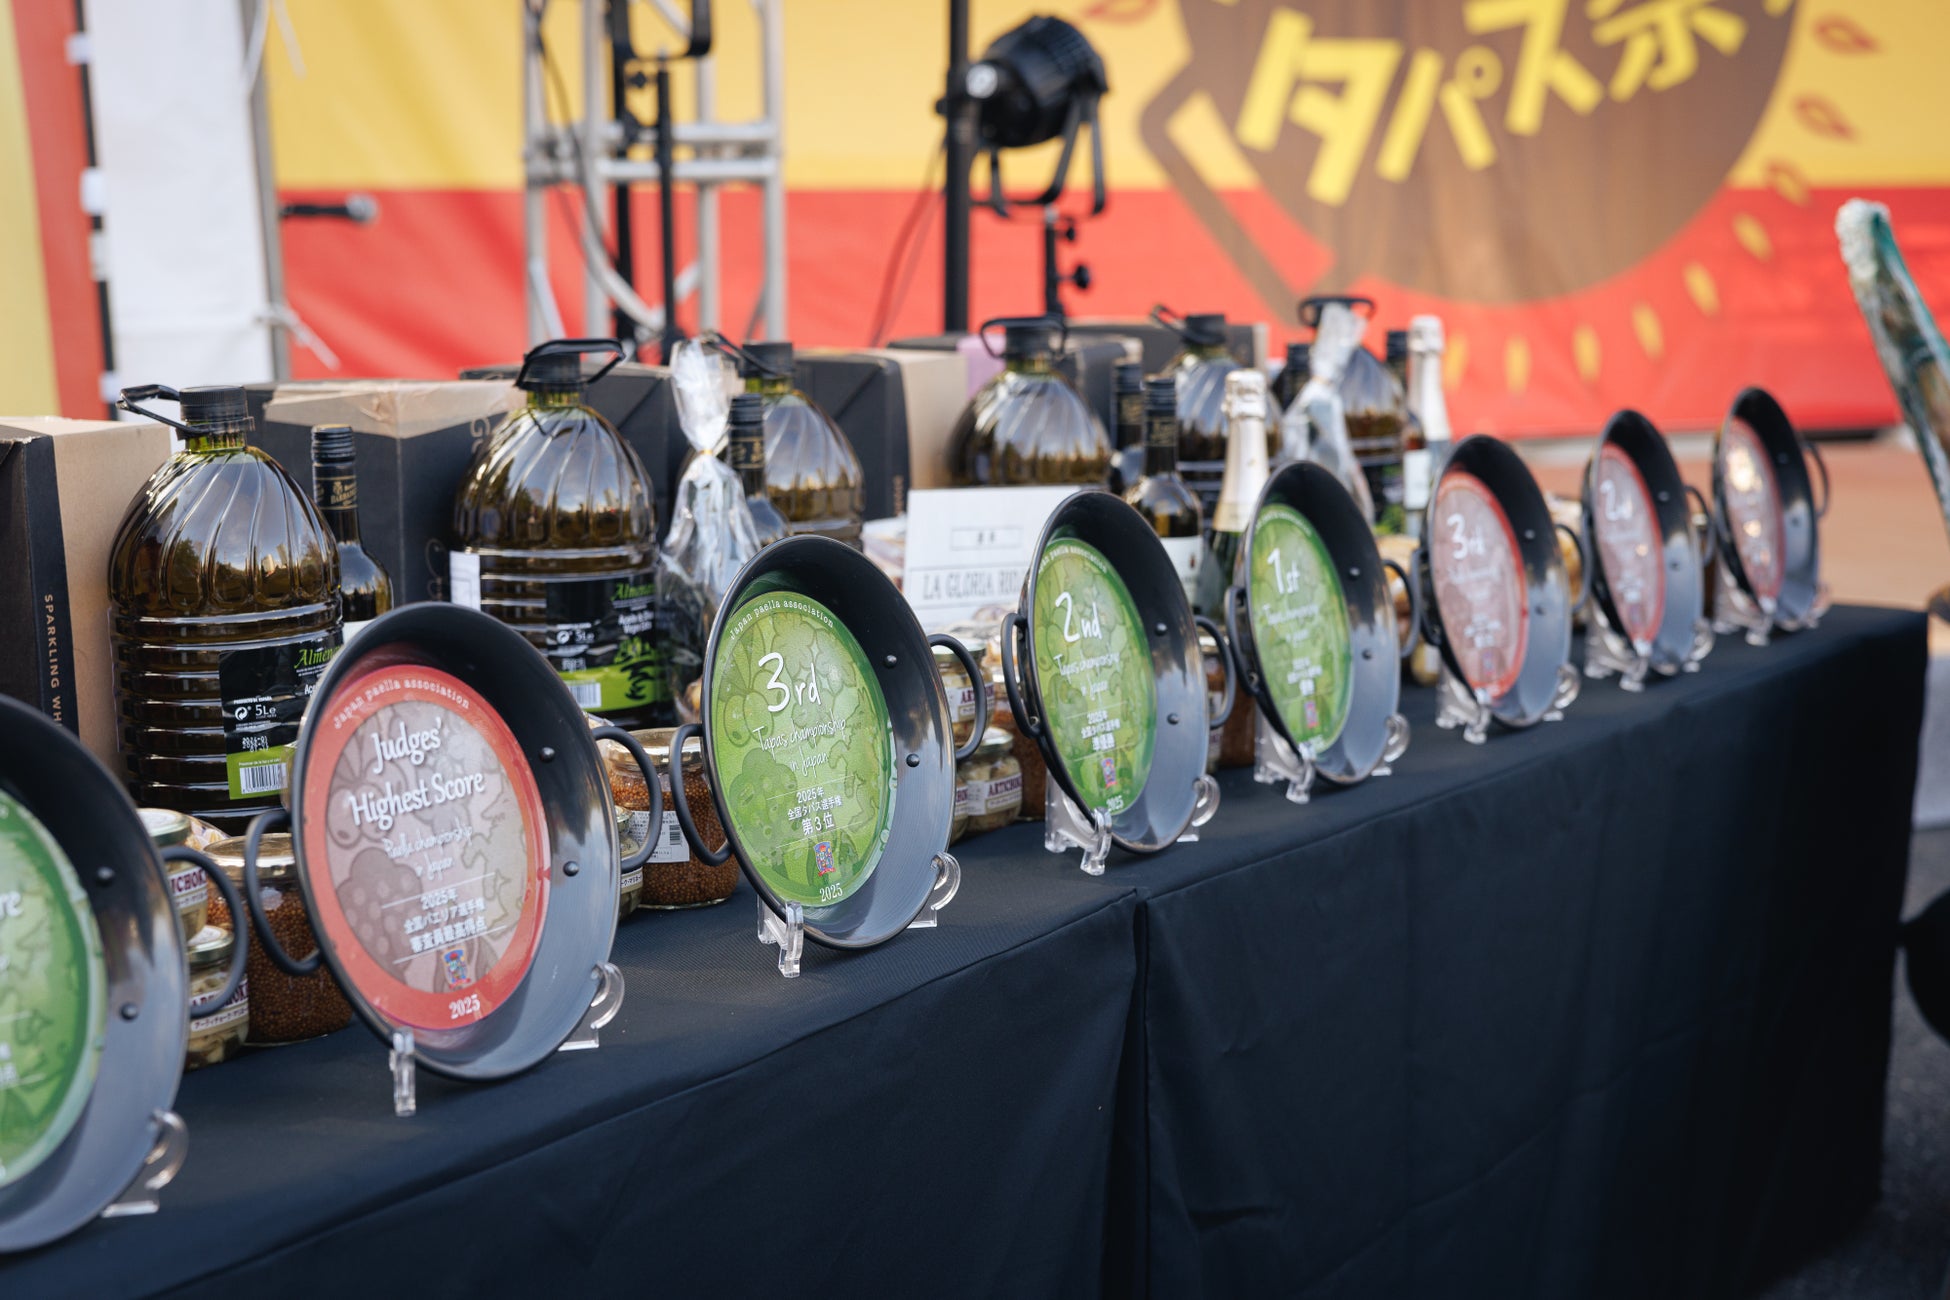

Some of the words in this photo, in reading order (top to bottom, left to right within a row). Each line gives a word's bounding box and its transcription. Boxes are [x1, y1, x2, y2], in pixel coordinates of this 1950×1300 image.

[730, 613, 752, 640] Japan
[754, 600, 781, 618] paella
[783, 600, 834, 628] association
[1055, 591, 1103, 643] 2nd
[44, 594, 60, 688] SPARKLING
[333, 695, 363, 729] Japan
[365, 678, 401, 701] paella
[404, 679, 470, 709] association
[758, 652, 822, 712] 3rd
[752, 725, 788, 761] Tapas
[790, 708, 846, 749] championship
[800, 746, 828, 778] Japan
[348, 779, 432, 830] Highest
[431, 773, 485, 804] Score
[796, 786, 825, 804] 2025年
[801, 812, 834, 836] 第3位
[819, 882, 843, 902] 2025
[449, 994, 481, 1020] 2025
